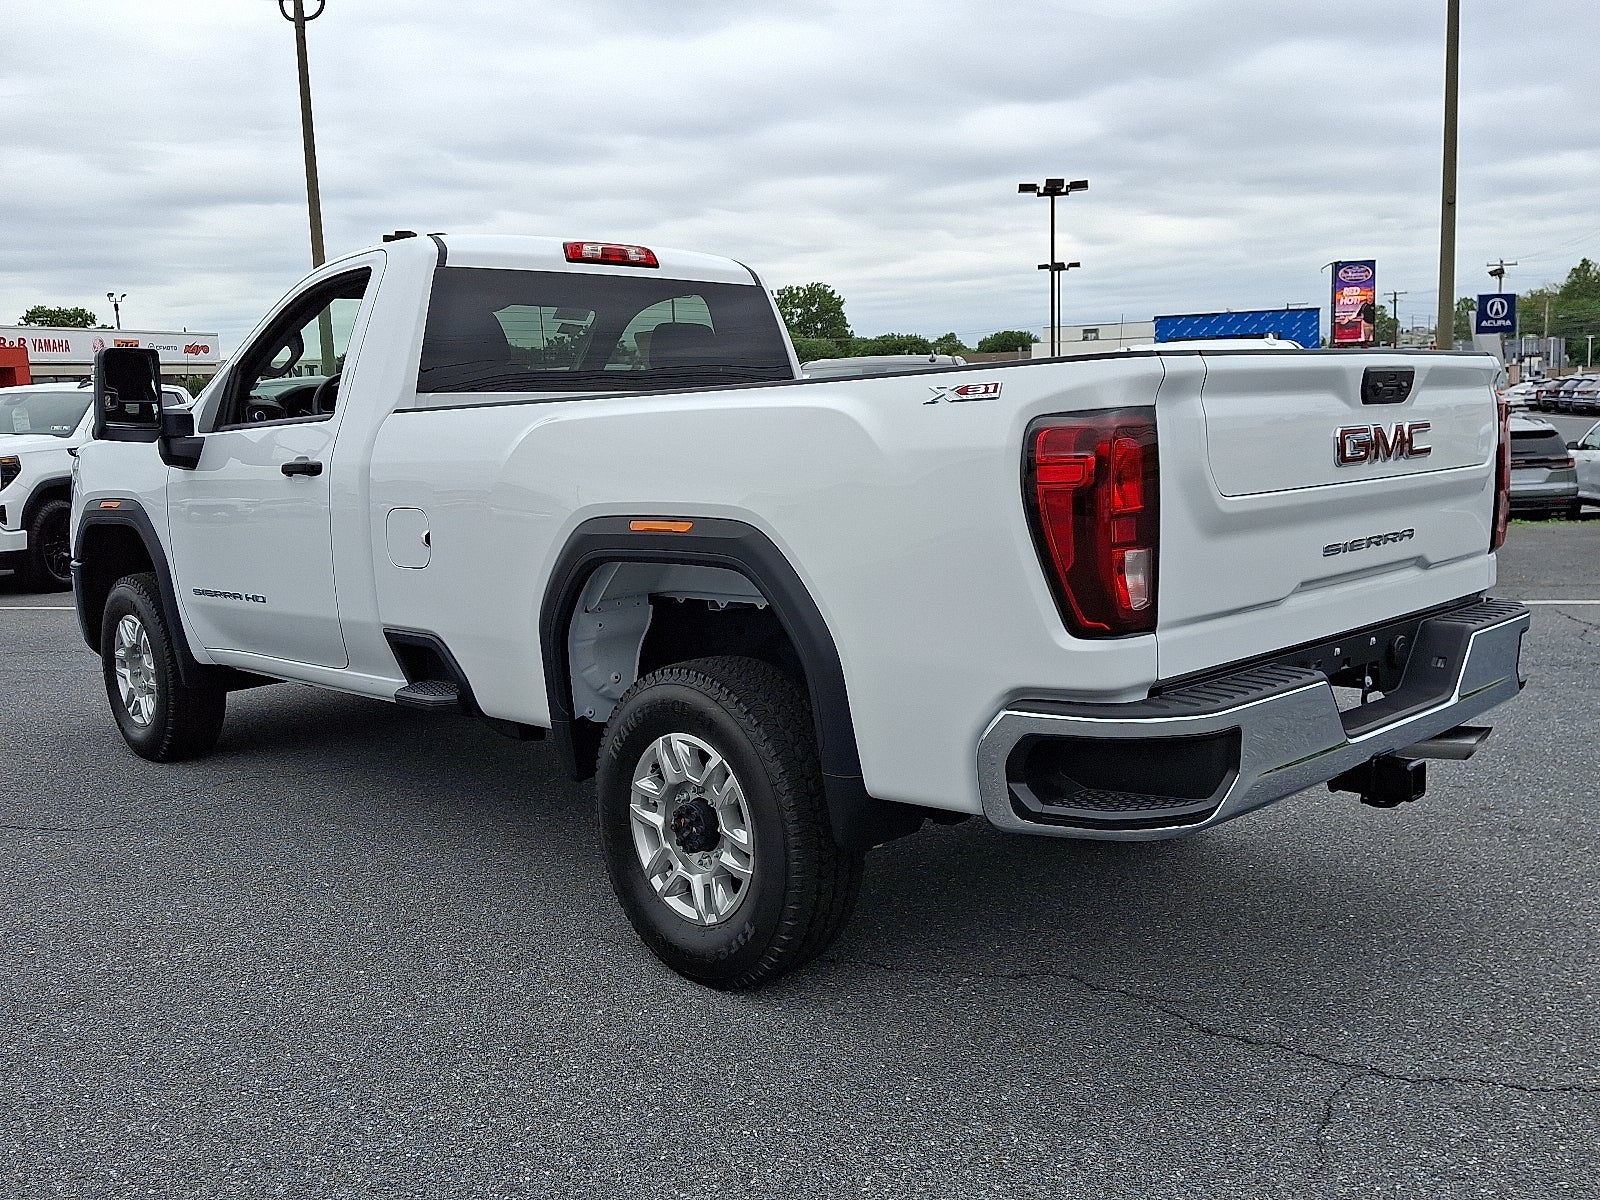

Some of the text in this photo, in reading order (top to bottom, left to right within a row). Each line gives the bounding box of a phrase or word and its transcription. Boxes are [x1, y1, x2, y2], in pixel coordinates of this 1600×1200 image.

[1343, 287, 1360, 296] RED
[1480, 319, 1513, 327] ACURA
[31, 338, 71, 353] YAMAHA
[1333, 420, 1432, 468] GMC
[1322, 528, 1415, 557] SIERRA
[192, 588, 267, 603] SIERRA HD
